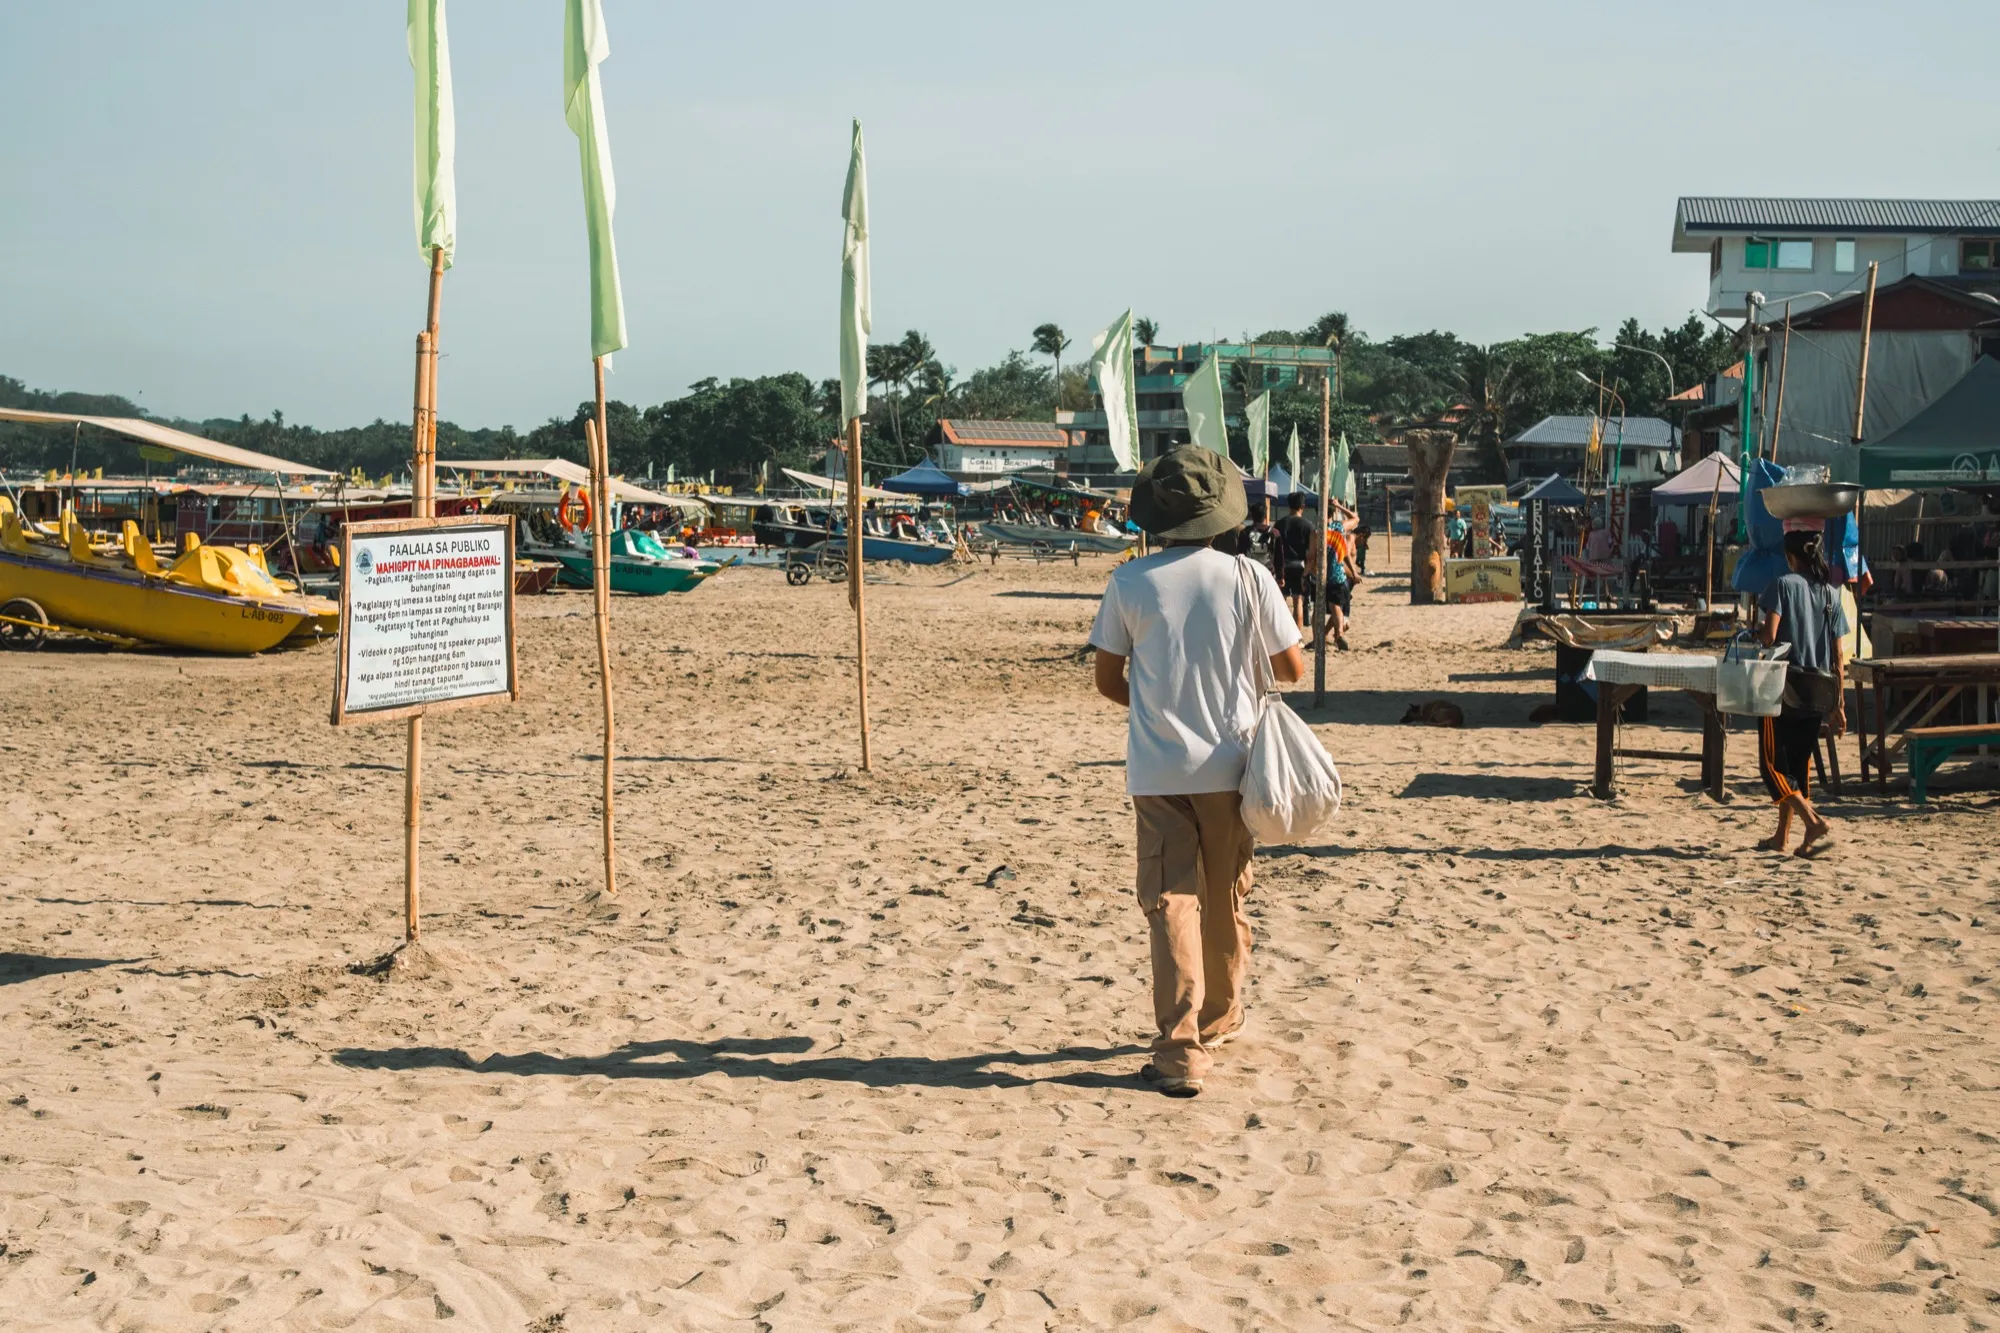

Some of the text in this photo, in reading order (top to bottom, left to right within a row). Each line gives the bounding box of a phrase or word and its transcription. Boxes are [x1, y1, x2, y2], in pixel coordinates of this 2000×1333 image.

[389, 539, 490, 557] PAALALA SA PUBLIKO
[376, 559, 416, 574] MAHIGPIT
[418, 558, 431, 571] NA
[432, 555, 501, 570] IPINAGBABAWAL:
[436, 571, 444, 579] sa
[445, 568, 466, 580] tabing
[467, 568, 485, 580] dagat
[410, 583, 451, 593] buhanginan
[394, 599, 401, 608] ng
[425, 595, 433, 603] sa
[434, 593, 456, 604] tabing
[457, 590, 476, 601] dagat
[477, 589, 492, 599] mula
[492, 588, 503, 597] 6am
[354, 612, 387, 624] hanggang
[387, 612, 401, 620] 6pm
[408, 607, 433, 617] lampas
[443, 604, 467, 614] zoning
[467, 605, 475, 613] ng
[476, 601, 503, 611] Barangay
[407, 621, 414, 630] ng
[416, 619, 431, 628] Tent
[441, 615, 482, 626] Paghuhukay
[482, 614, 490, 622] sa
[410, 629, 449, 640] buhanginan
[448, 639, 475, 650] speaker
[477, 635, 502, 646] pagsapit
[392, 650, 466, 667] ng 10pm hanggang 6am
[402, 668, 415, 677] aso
[421, 664, 460, 676] pagtatapon
[461, 662, 469, 671] ng
[470, 659, 494, 668] basura
[394, 679, 411, 689] hindi
[437, 674, 464, 685] tapunan
